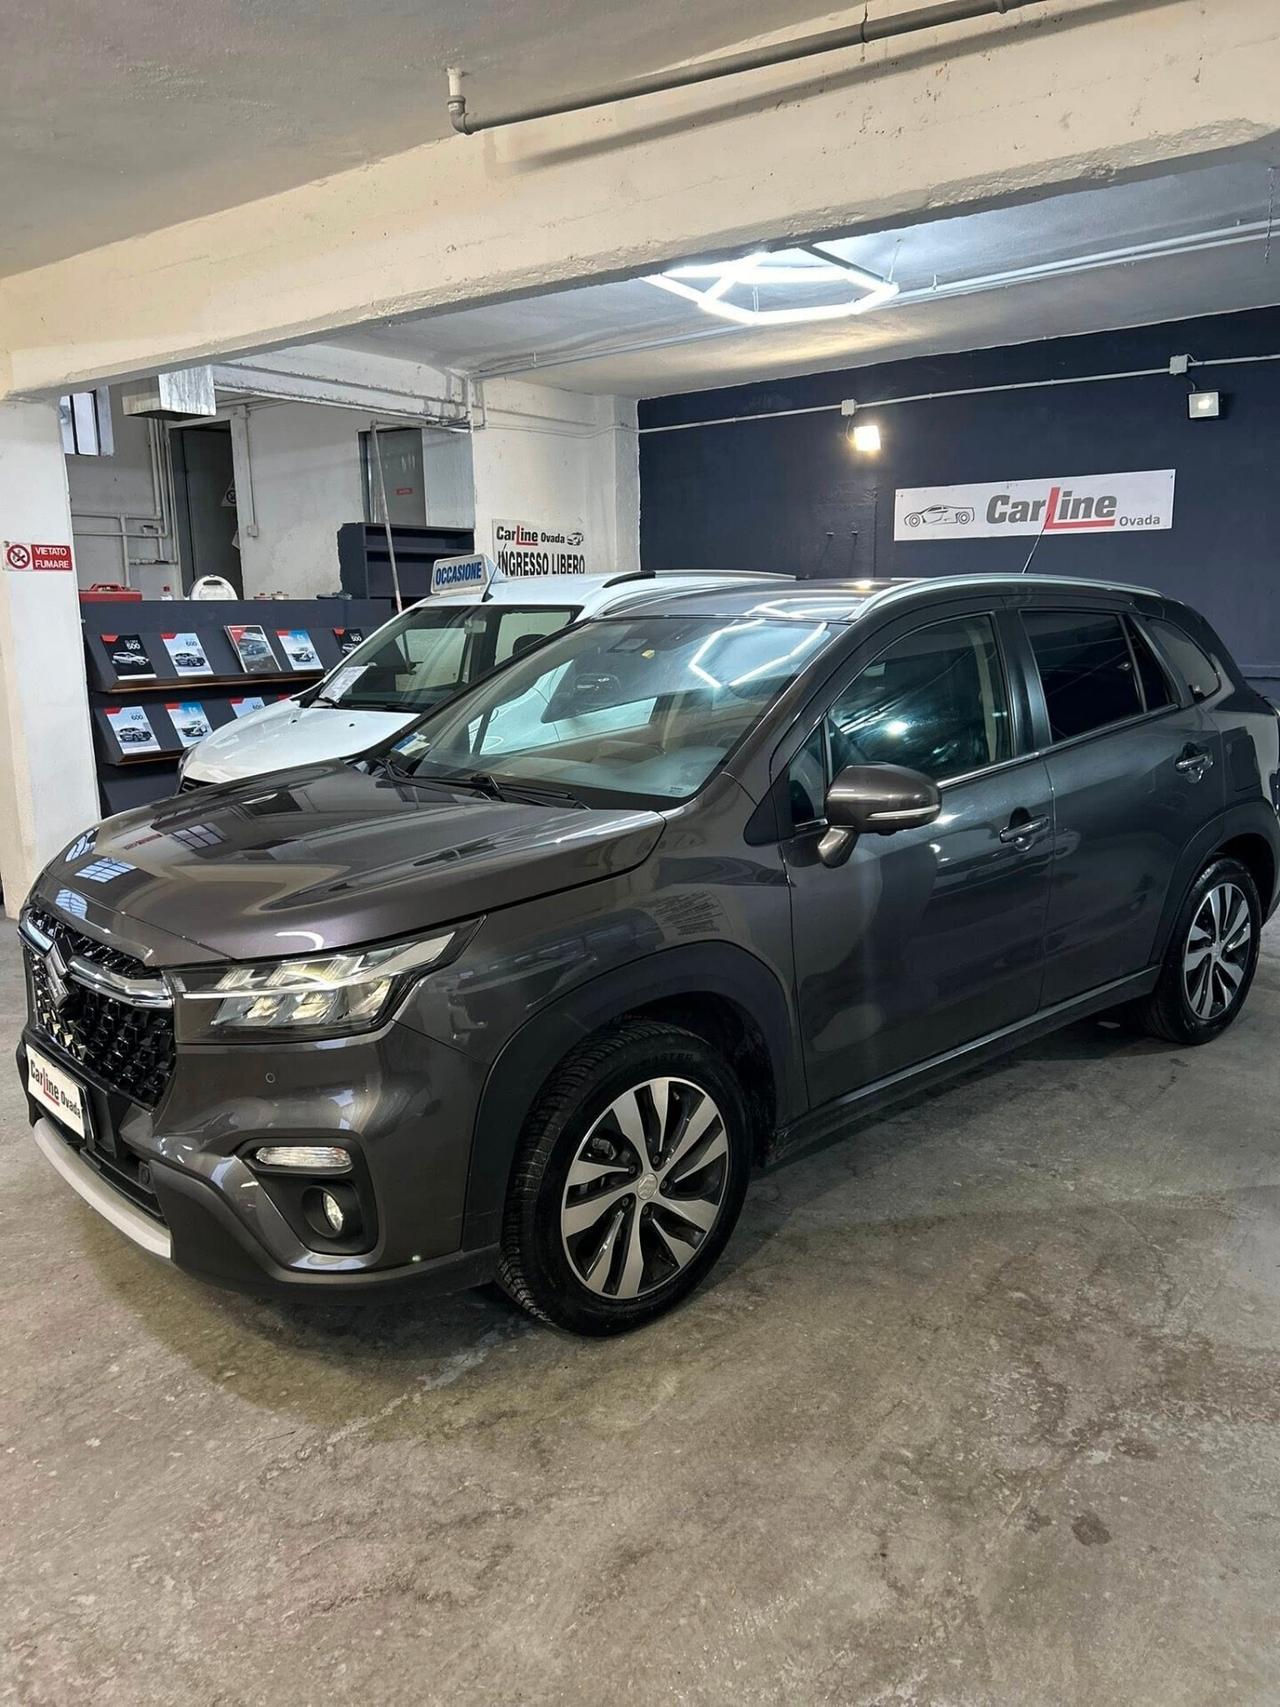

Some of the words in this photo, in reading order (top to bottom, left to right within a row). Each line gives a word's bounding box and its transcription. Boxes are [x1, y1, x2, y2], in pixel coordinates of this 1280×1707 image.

[986, 486, 1117, 530] CarLine
[1119, 515, 1161, 527] Ovada
[496, 525, 538, 546] CarLine
[541, 532, 565, 544] Ovada
[34, 547, 67, 556] VIETATO
[35, 560, 70, 569] FUMARE
[435, 561, 482, 585] OCCASIONE
[498, 551, 549, 577] INGRESSO
[551, 553, 585, 575] LIBERO
[30, 1059, 60, 1107] CarLine
[60, 1090, 81, 1119] Ovada
